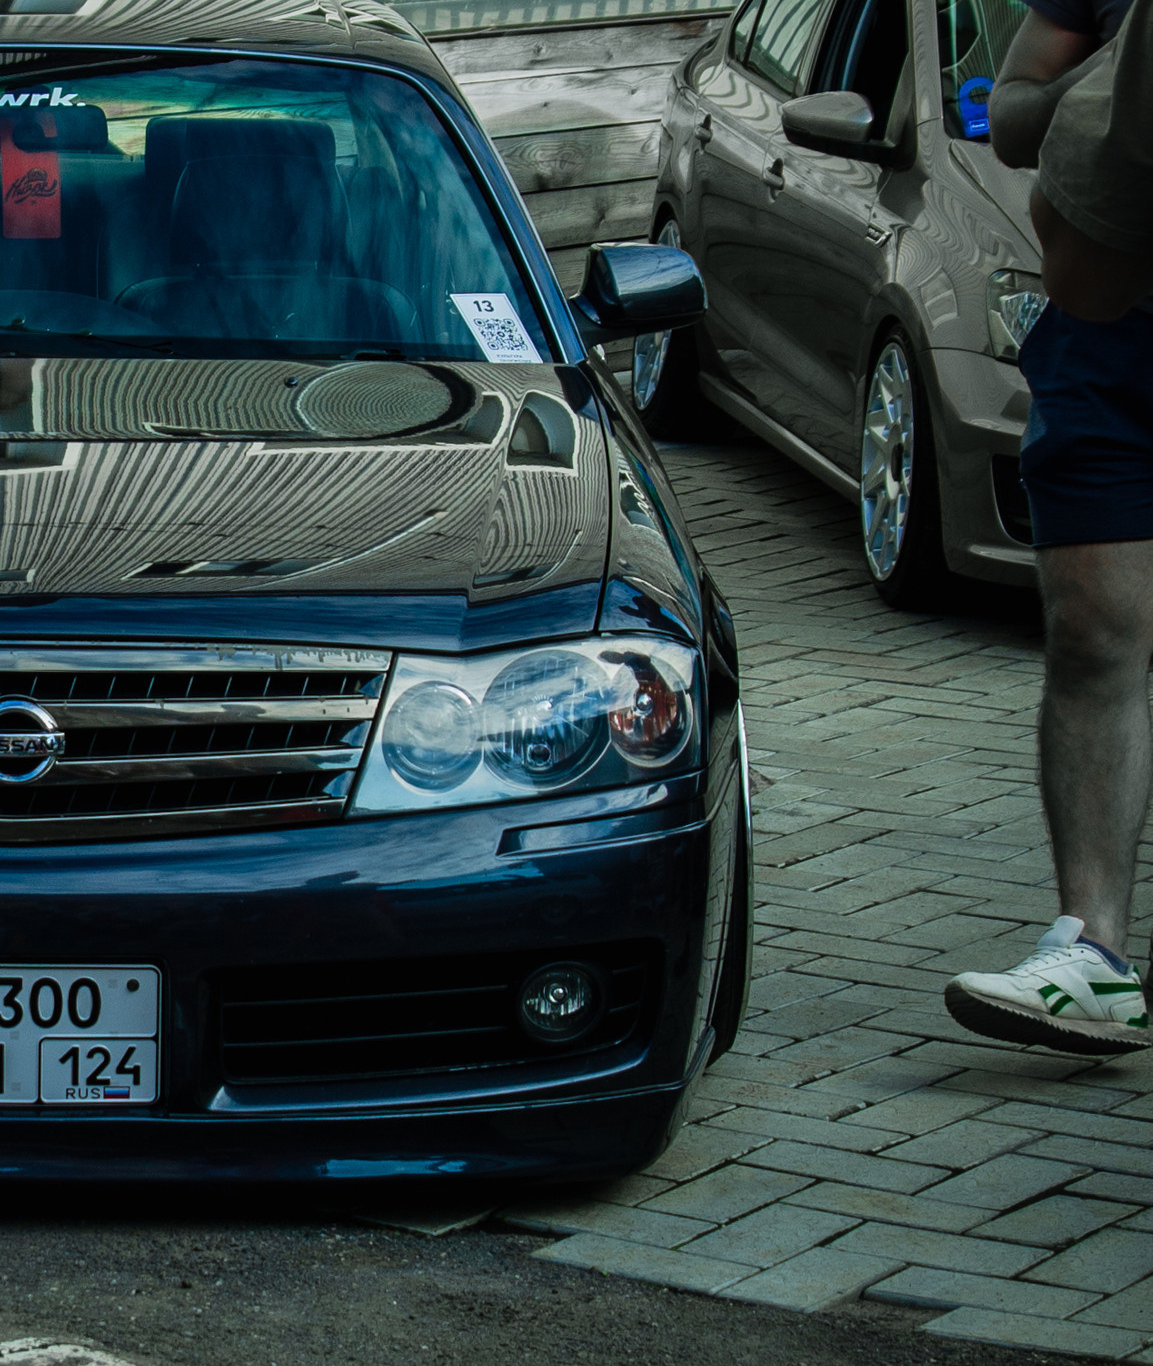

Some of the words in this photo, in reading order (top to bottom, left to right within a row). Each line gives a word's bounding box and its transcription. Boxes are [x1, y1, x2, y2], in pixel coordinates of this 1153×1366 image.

[473, 300, 495, 312] 13
[59, 1045, 141, 1086] 124
[65, 1088, 101, 1099] RUS
